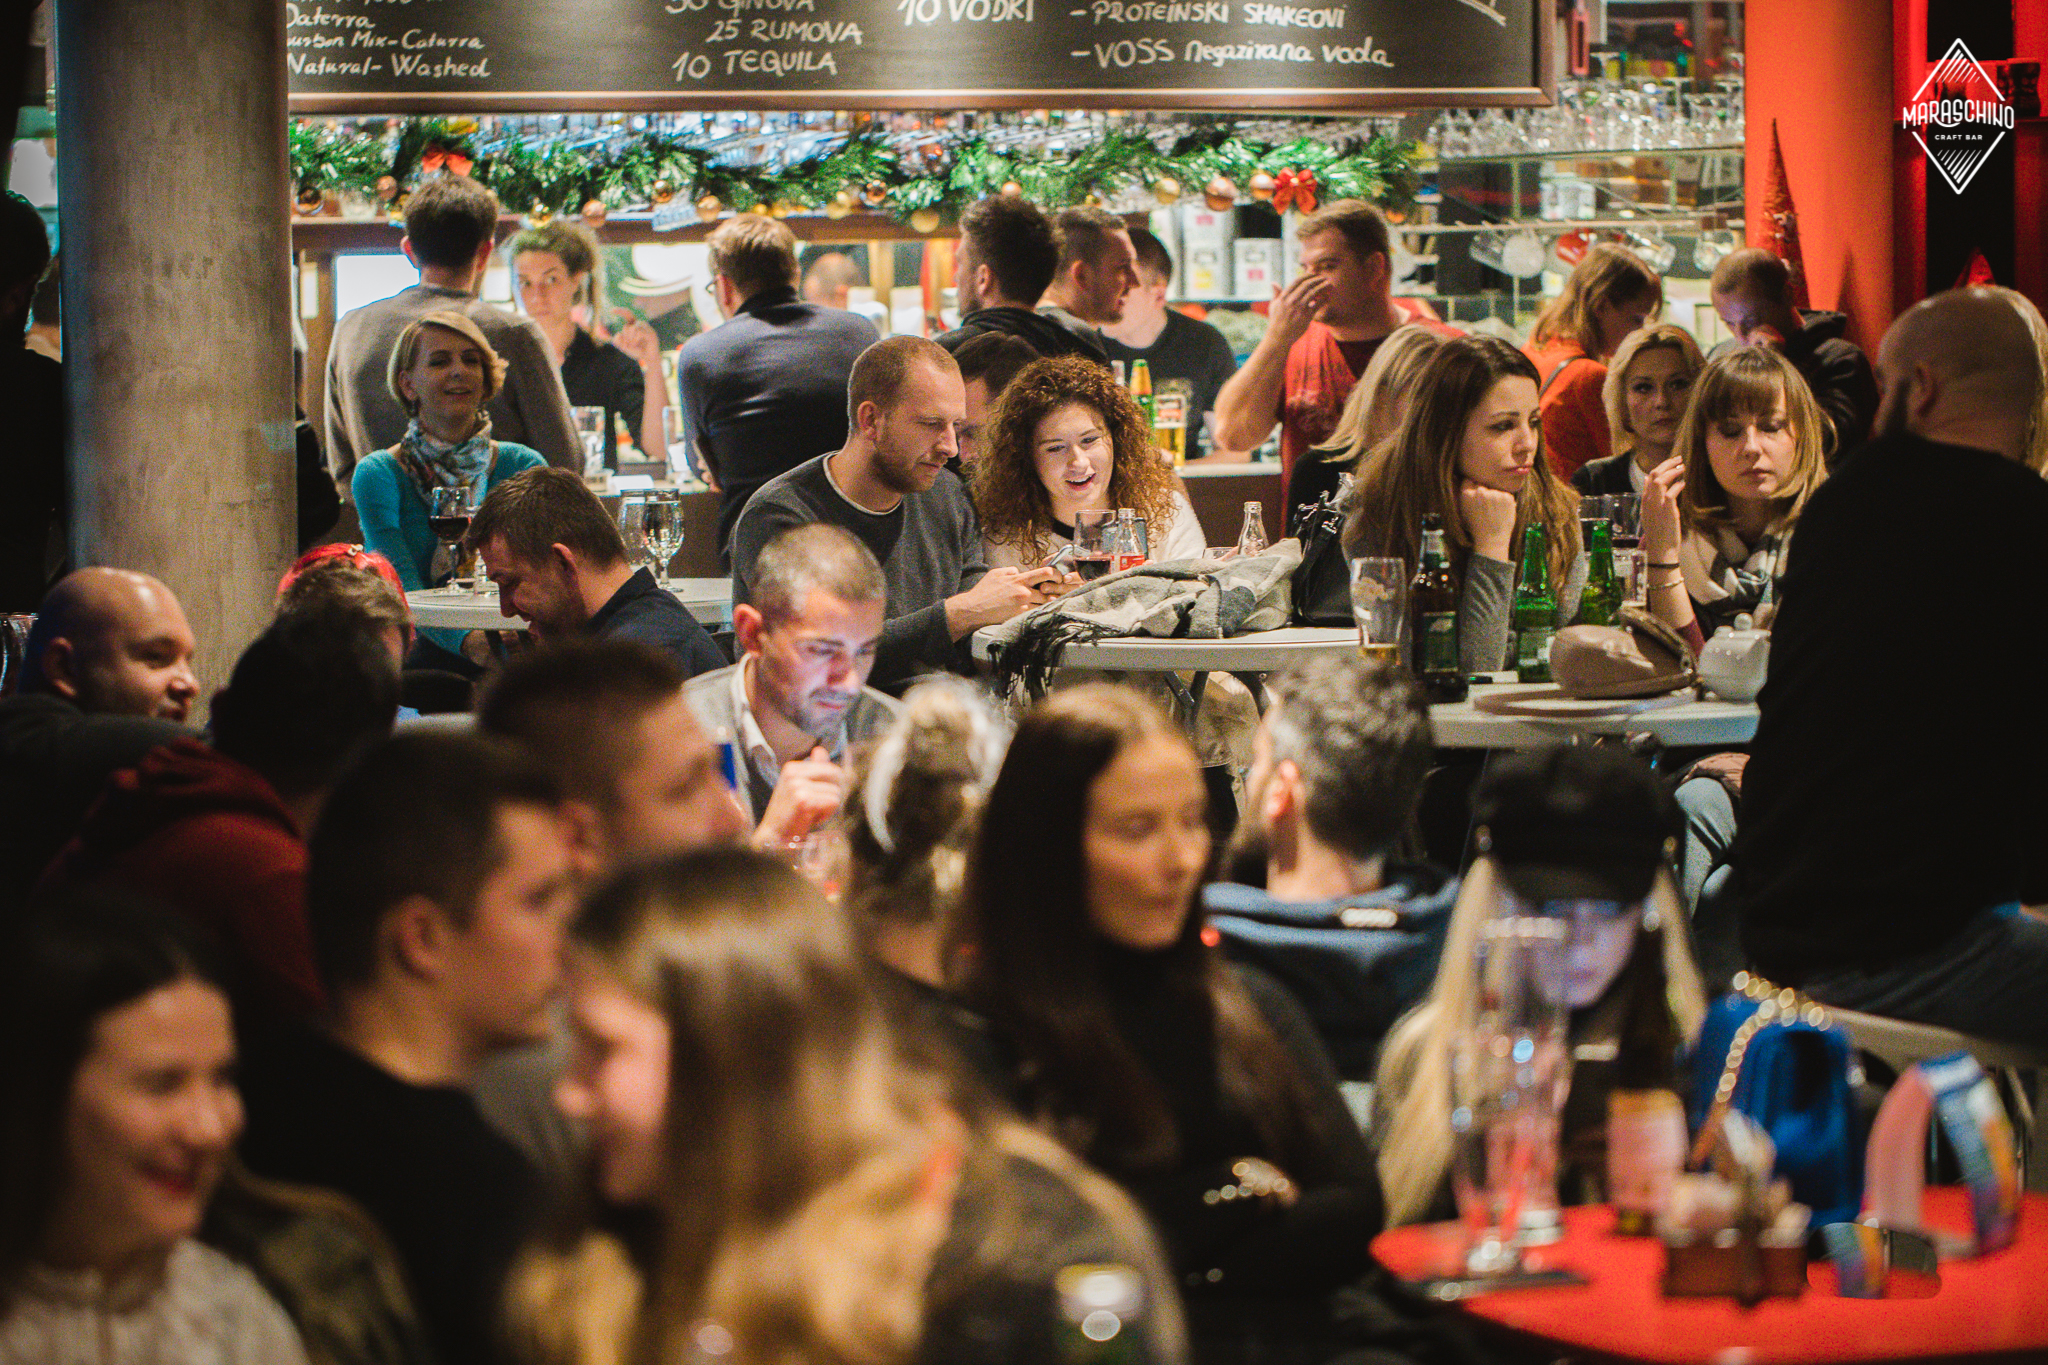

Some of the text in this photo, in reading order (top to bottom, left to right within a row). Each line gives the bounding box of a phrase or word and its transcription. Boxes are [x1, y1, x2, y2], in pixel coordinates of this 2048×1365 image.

[705, 18, 863, 45] 25 RUMOVA
[391, 52, 491, 78] Washed
[671, 49, 838, 82] 10 TEQUILA
[1321, 36, 1395, 67] voda
